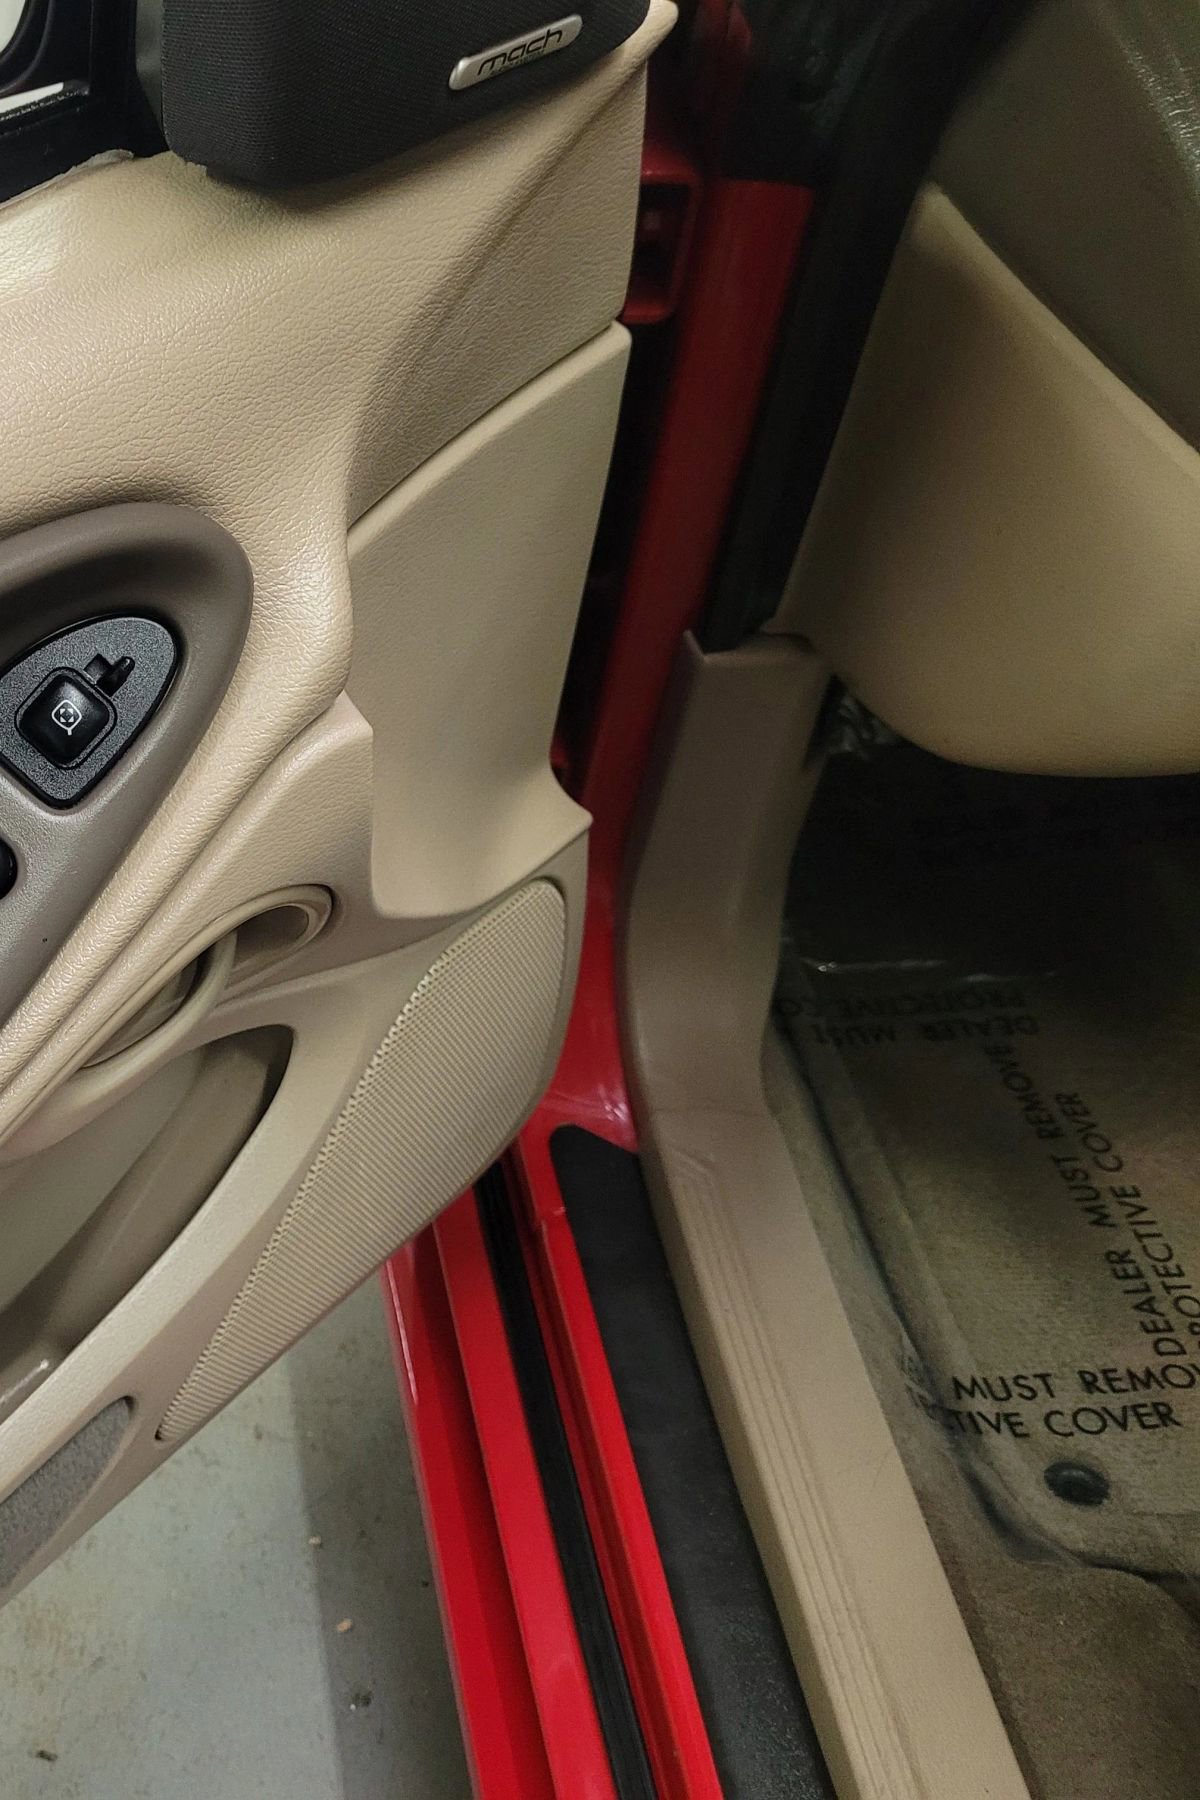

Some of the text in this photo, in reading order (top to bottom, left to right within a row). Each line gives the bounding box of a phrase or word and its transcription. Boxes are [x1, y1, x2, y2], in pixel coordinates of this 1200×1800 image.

[477, 28, 563, 76] mach
[1050, 1153, 1118, 1228] MUST
[1055, 1091, 1200, 1351] OTECTIVE COVER
[1104, 1248, 1187, 1357] DEALER
[951, 1372, 1057, 1402] MUST
[1077, 1363, 1200, 1395] REMO
[1043, 1401, 1183, 1438] COVER
